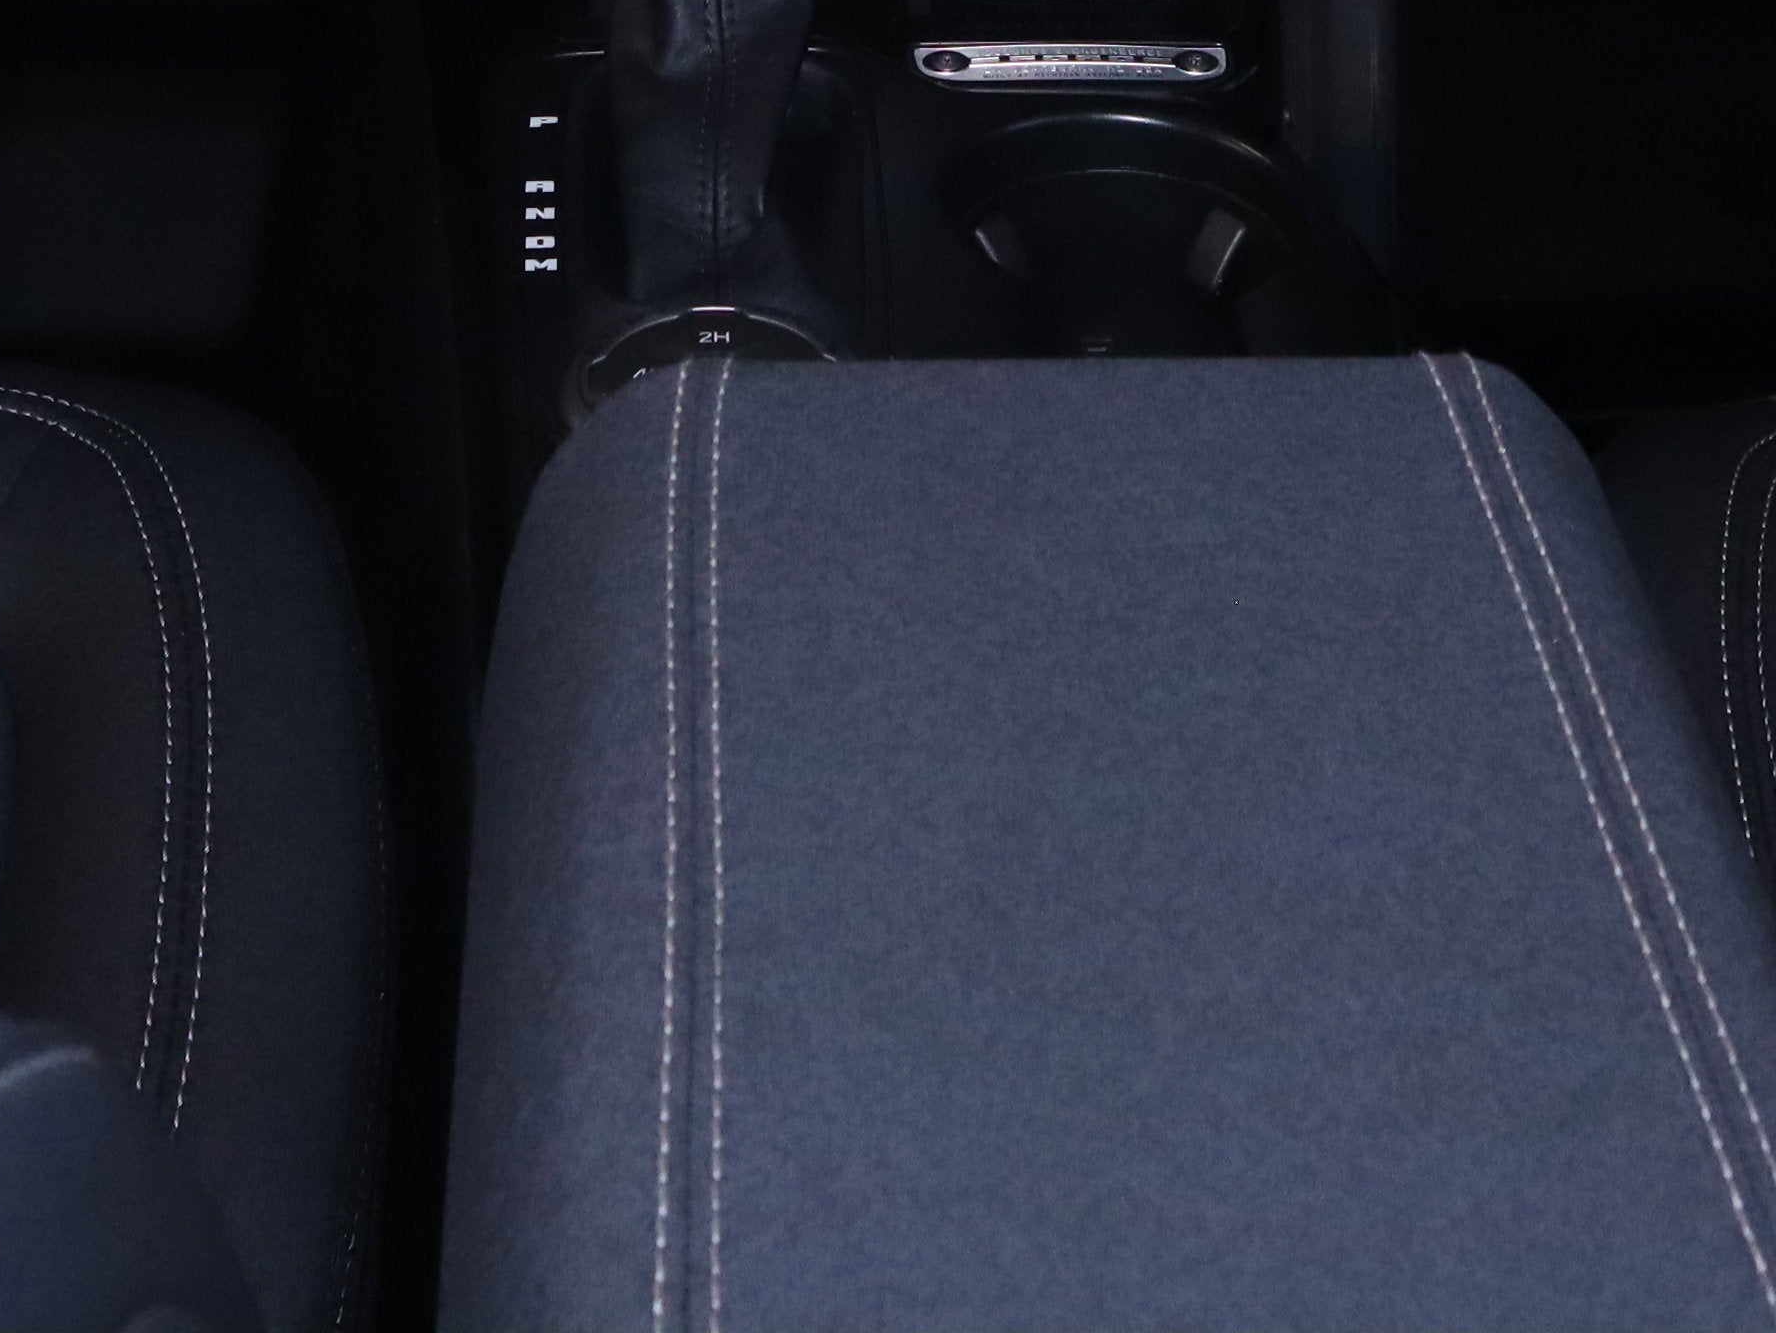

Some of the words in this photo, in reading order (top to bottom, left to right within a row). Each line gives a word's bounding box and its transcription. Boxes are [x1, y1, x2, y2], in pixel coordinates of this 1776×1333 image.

[529, 115, 558, 128] P
[525, 207, 556, 219] N
[525, 235, 556, 249] D
[525, 258, 558, 272] M
[698, 331, 731, 344] 2H
